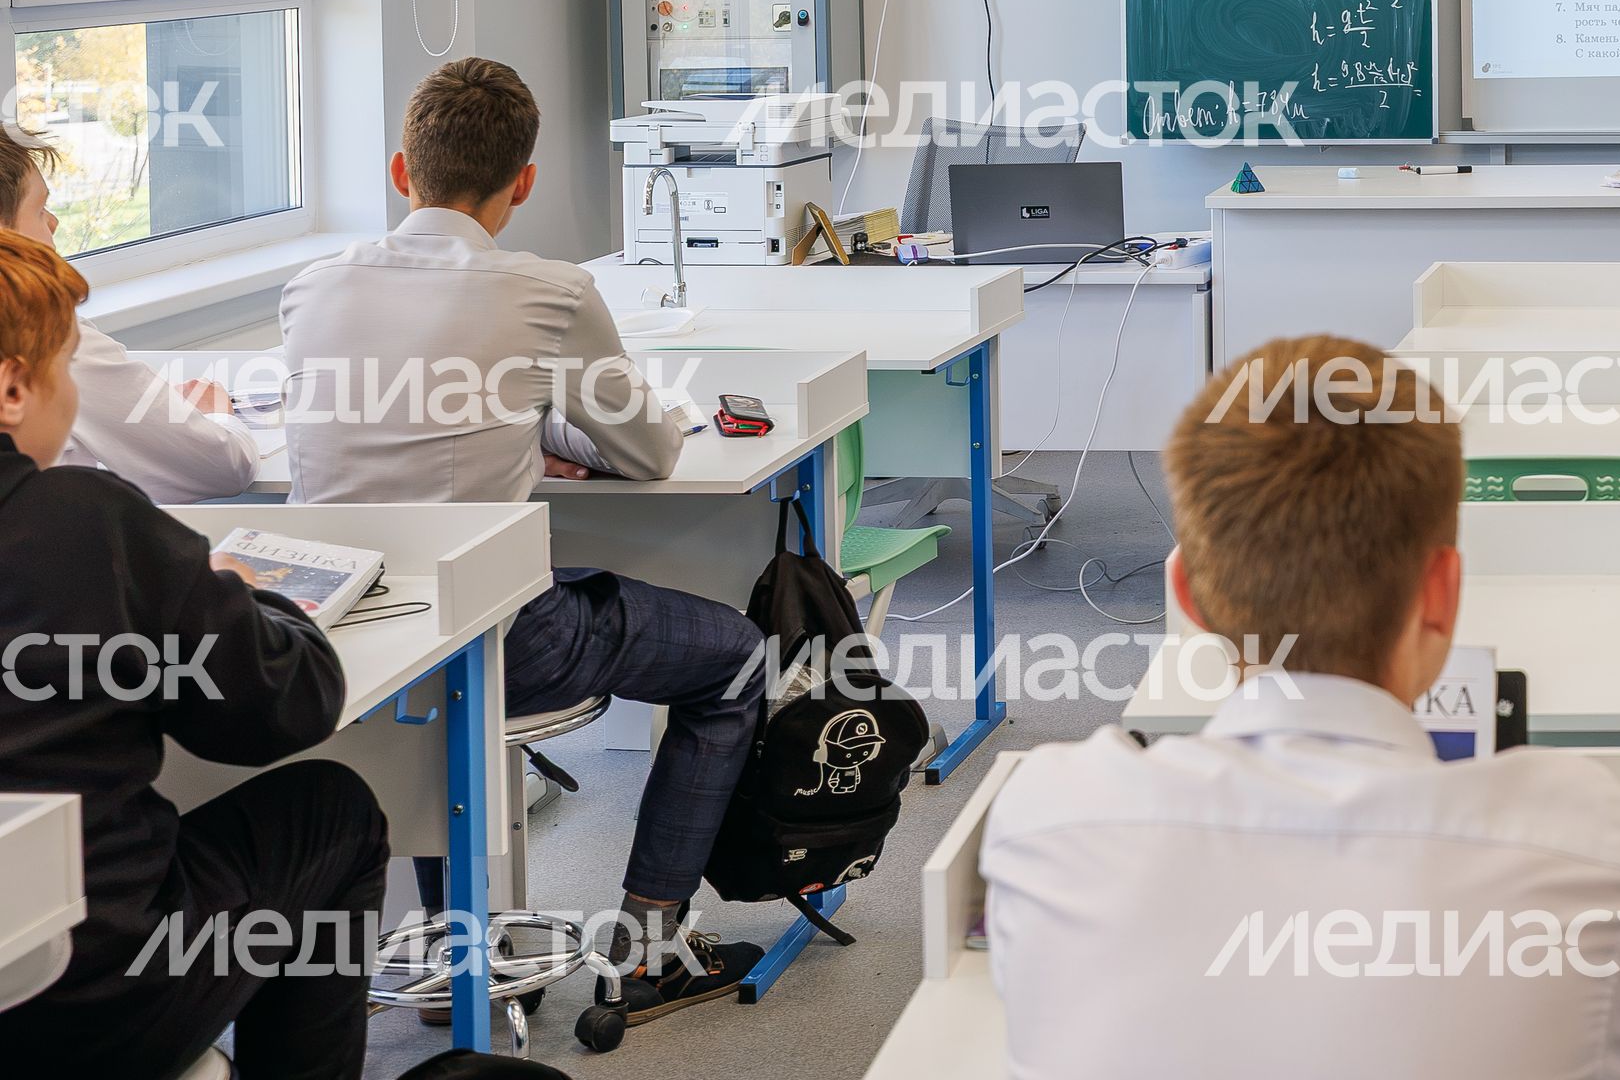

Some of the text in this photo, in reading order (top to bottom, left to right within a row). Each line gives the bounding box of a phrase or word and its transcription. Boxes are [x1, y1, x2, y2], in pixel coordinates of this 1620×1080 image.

[1574, 1, 1600, 12] Мяч
[1574, 18, 1607, 29] рость
[1575, 32, 1619, 44] Камень
[236, 541, 358, 570] ФИЗИКА
